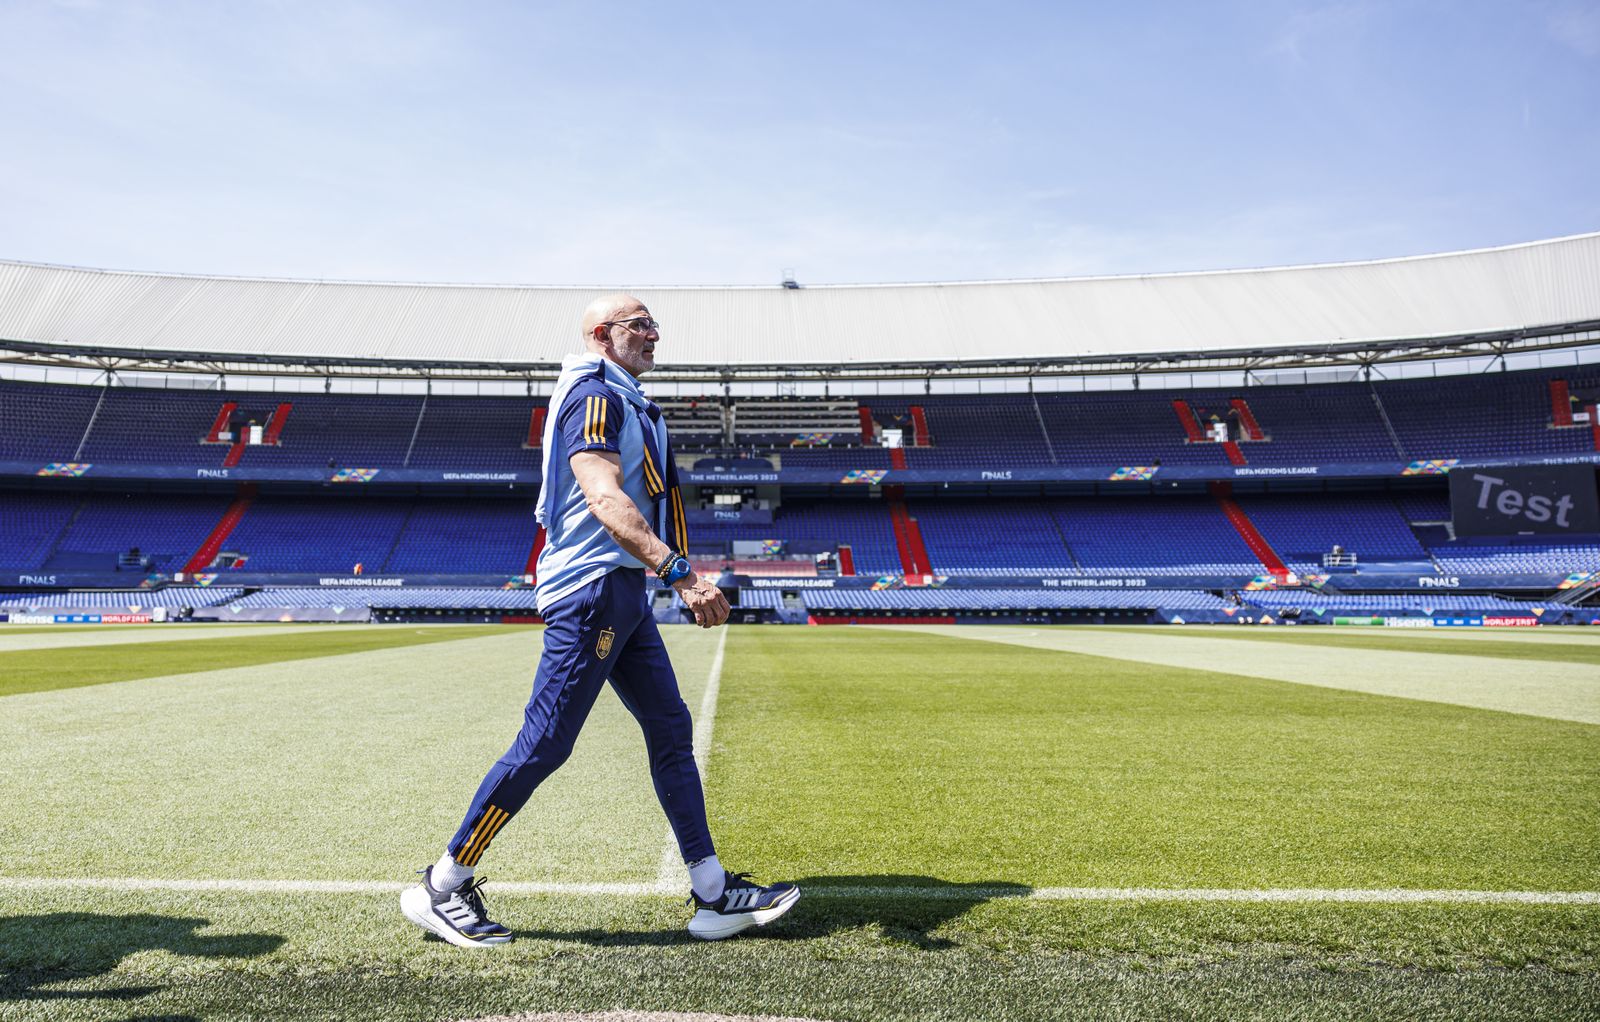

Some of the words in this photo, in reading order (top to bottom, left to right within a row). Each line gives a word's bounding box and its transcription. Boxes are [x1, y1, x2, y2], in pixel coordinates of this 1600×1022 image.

[197, 469, 228, 478] FINALS
[1254, 467, 1287, 475] NATIONS
[1287, 466, 1318, 474] LEAGUE
[982, 471, 1012, 480] FINALS
[1473, 474, 1574, 527] Test
[19, 575, 56, 585] FINALS
[320, 578, 339, 586] UEFA
[339, 578, 372, 586] NATIONS
[372, 578, 403, 586] LEAGUE
[752, 579, 771, 587] UEFA
[771, 579, 804, 587] NATIONS
[804, 579, 835, 587] LEAGUE
[1061, 579, 1124, 587] NETHERLANDS
[1125, 579, 1147, 587] 2023
[1419, 577, 1460, 587] FINALS
[8, 614, 54, 624] Hisense
[1384, 617, 1434, 627] Hisense
